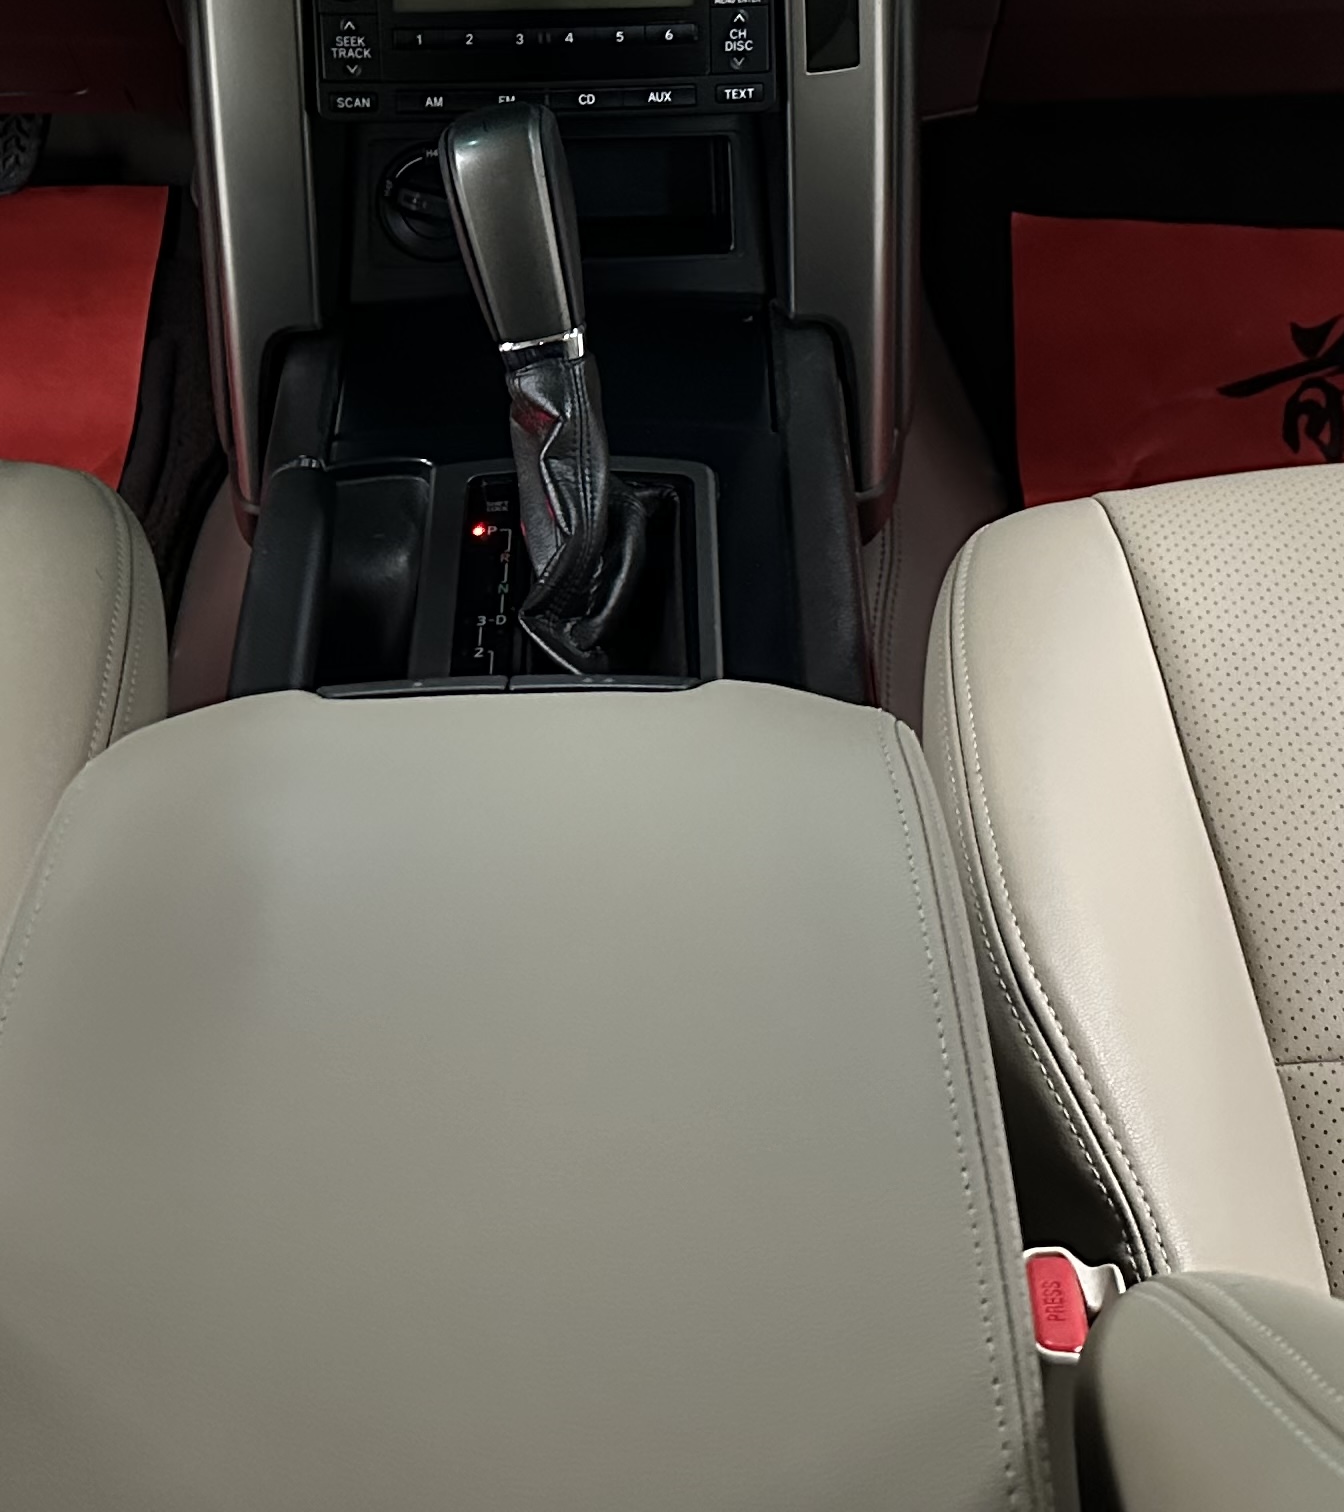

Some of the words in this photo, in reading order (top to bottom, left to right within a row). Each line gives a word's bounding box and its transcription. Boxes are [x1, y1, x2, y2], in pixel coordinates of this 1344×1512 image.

[416, 34, 423, 45] 1
[465, 34, 473, 45] 2
[516, 34, 524, 45] 3
[565, 33, 574, 43] 4
[616, 31, 624, 42] 5
[665, 29, 674, 40] 6
[729, 29, 747, 39] CH
[335, 36, 365, 47] SEEK
[724, 40, 753, 51] DISC
[331, 48, 371, 59] TRACK
[578, 94, 595, 105] CD
[648, 91, 672, 102] AUX
[724, 88, 754, 100] TEXT
[337, 97, 370, 108] SCAN
[425, 96, 443, 107] AM
[487, 525, 498, 535] P
[498, 584, 509, 594] N
[476, 615, 486, 626] 3
[496, 615, 507, 626] D
[473, 647, 485, 658] 2
[1041, 1279, 1068, 1323] PRESS
